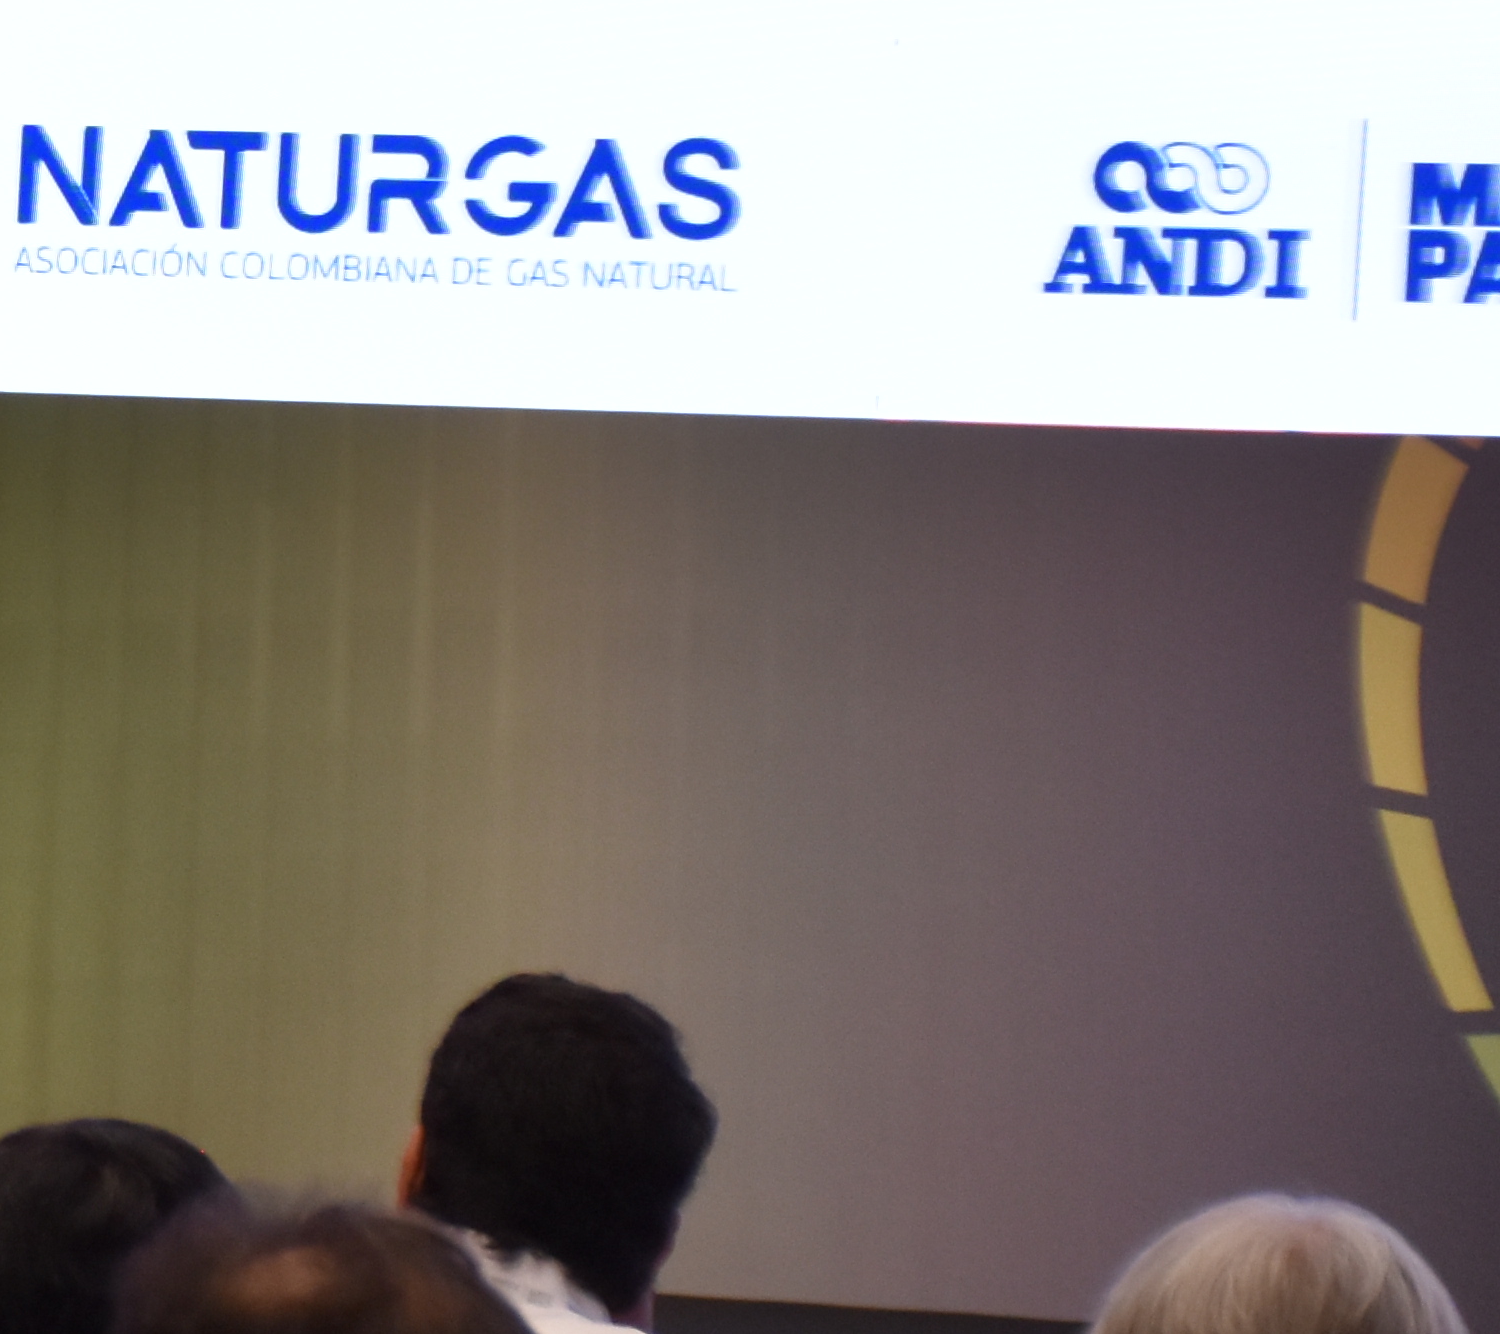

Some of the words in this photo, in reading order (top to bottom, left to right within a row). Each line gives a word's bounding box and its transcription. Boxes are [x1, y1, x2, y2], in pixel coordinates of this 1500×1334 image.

[17, 124, 740, 240] NATURGAS
[15, 244, 208, 277] ASOCIACIÓN
[220, 250, 438, 283] COLOMBIANA
[452, 256, 493, 286] DE
[507, 258, 569, 288] GAS
[583, 261, 739, 292] NATURAL
[1043, 225, 1311, 299] ANDI
